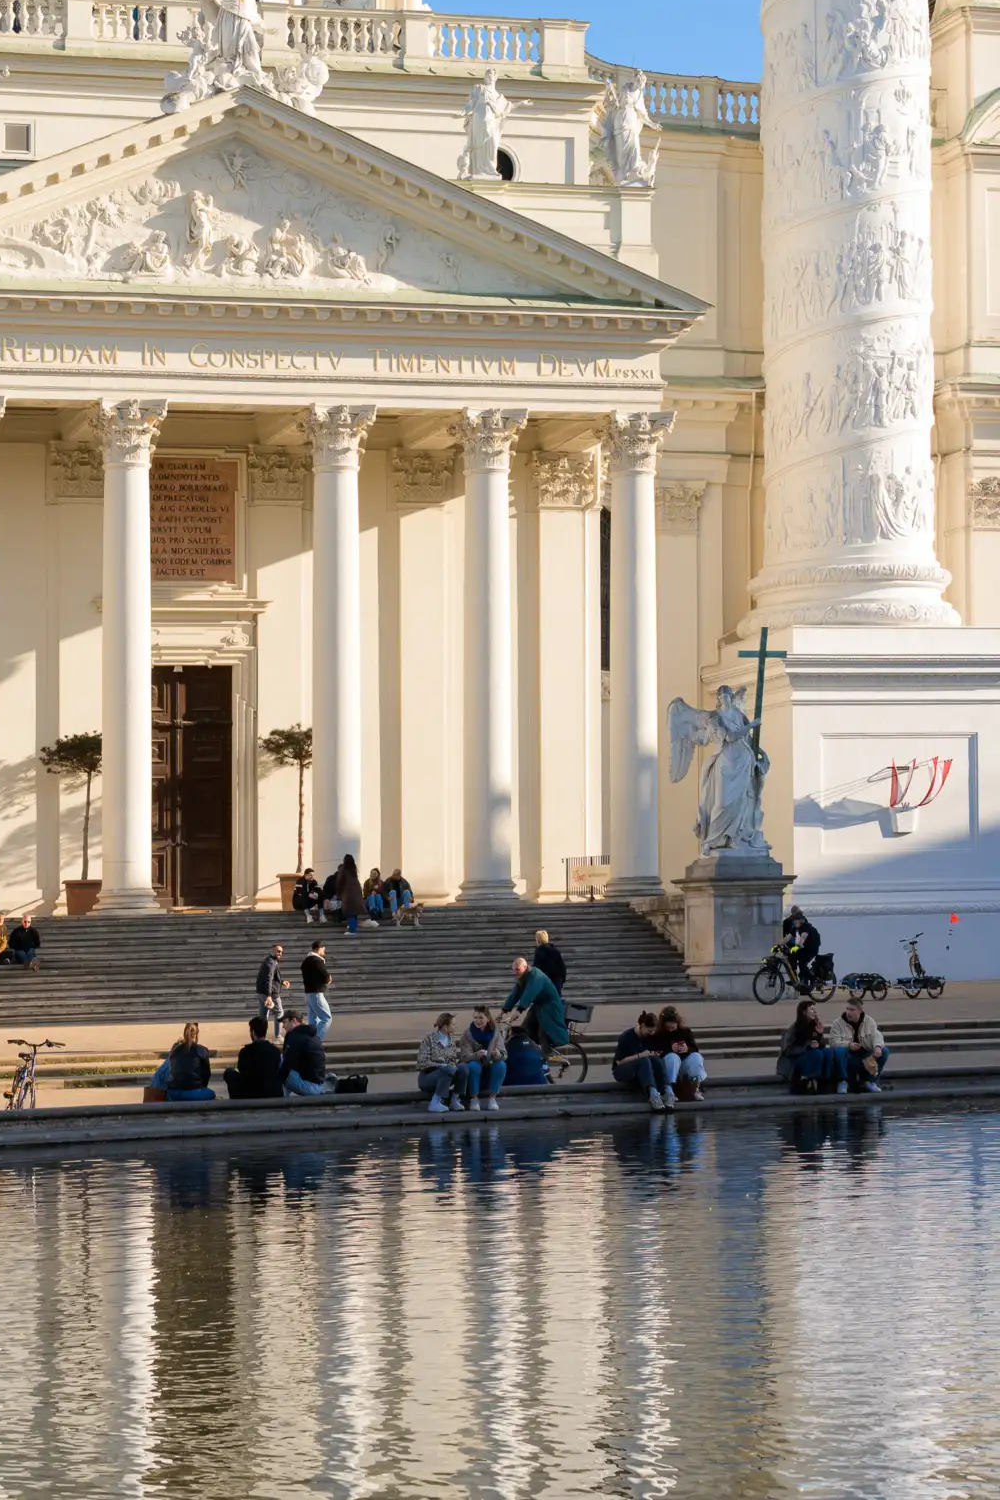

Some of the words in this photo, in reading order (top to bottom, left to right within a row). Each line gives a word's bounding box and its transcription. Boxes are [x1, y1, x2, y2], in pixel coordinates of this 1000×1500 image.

[0, 337, 119, 365] REDDAM
[141, 342, 167, 366] IN
[188, 344, 344, 370] CONSPECTV
[368, 348, 517, 376] TIMENTIVM
[537, 353, 613, 378] DEVM
[168, 463, 206, 471] GLORIAM
